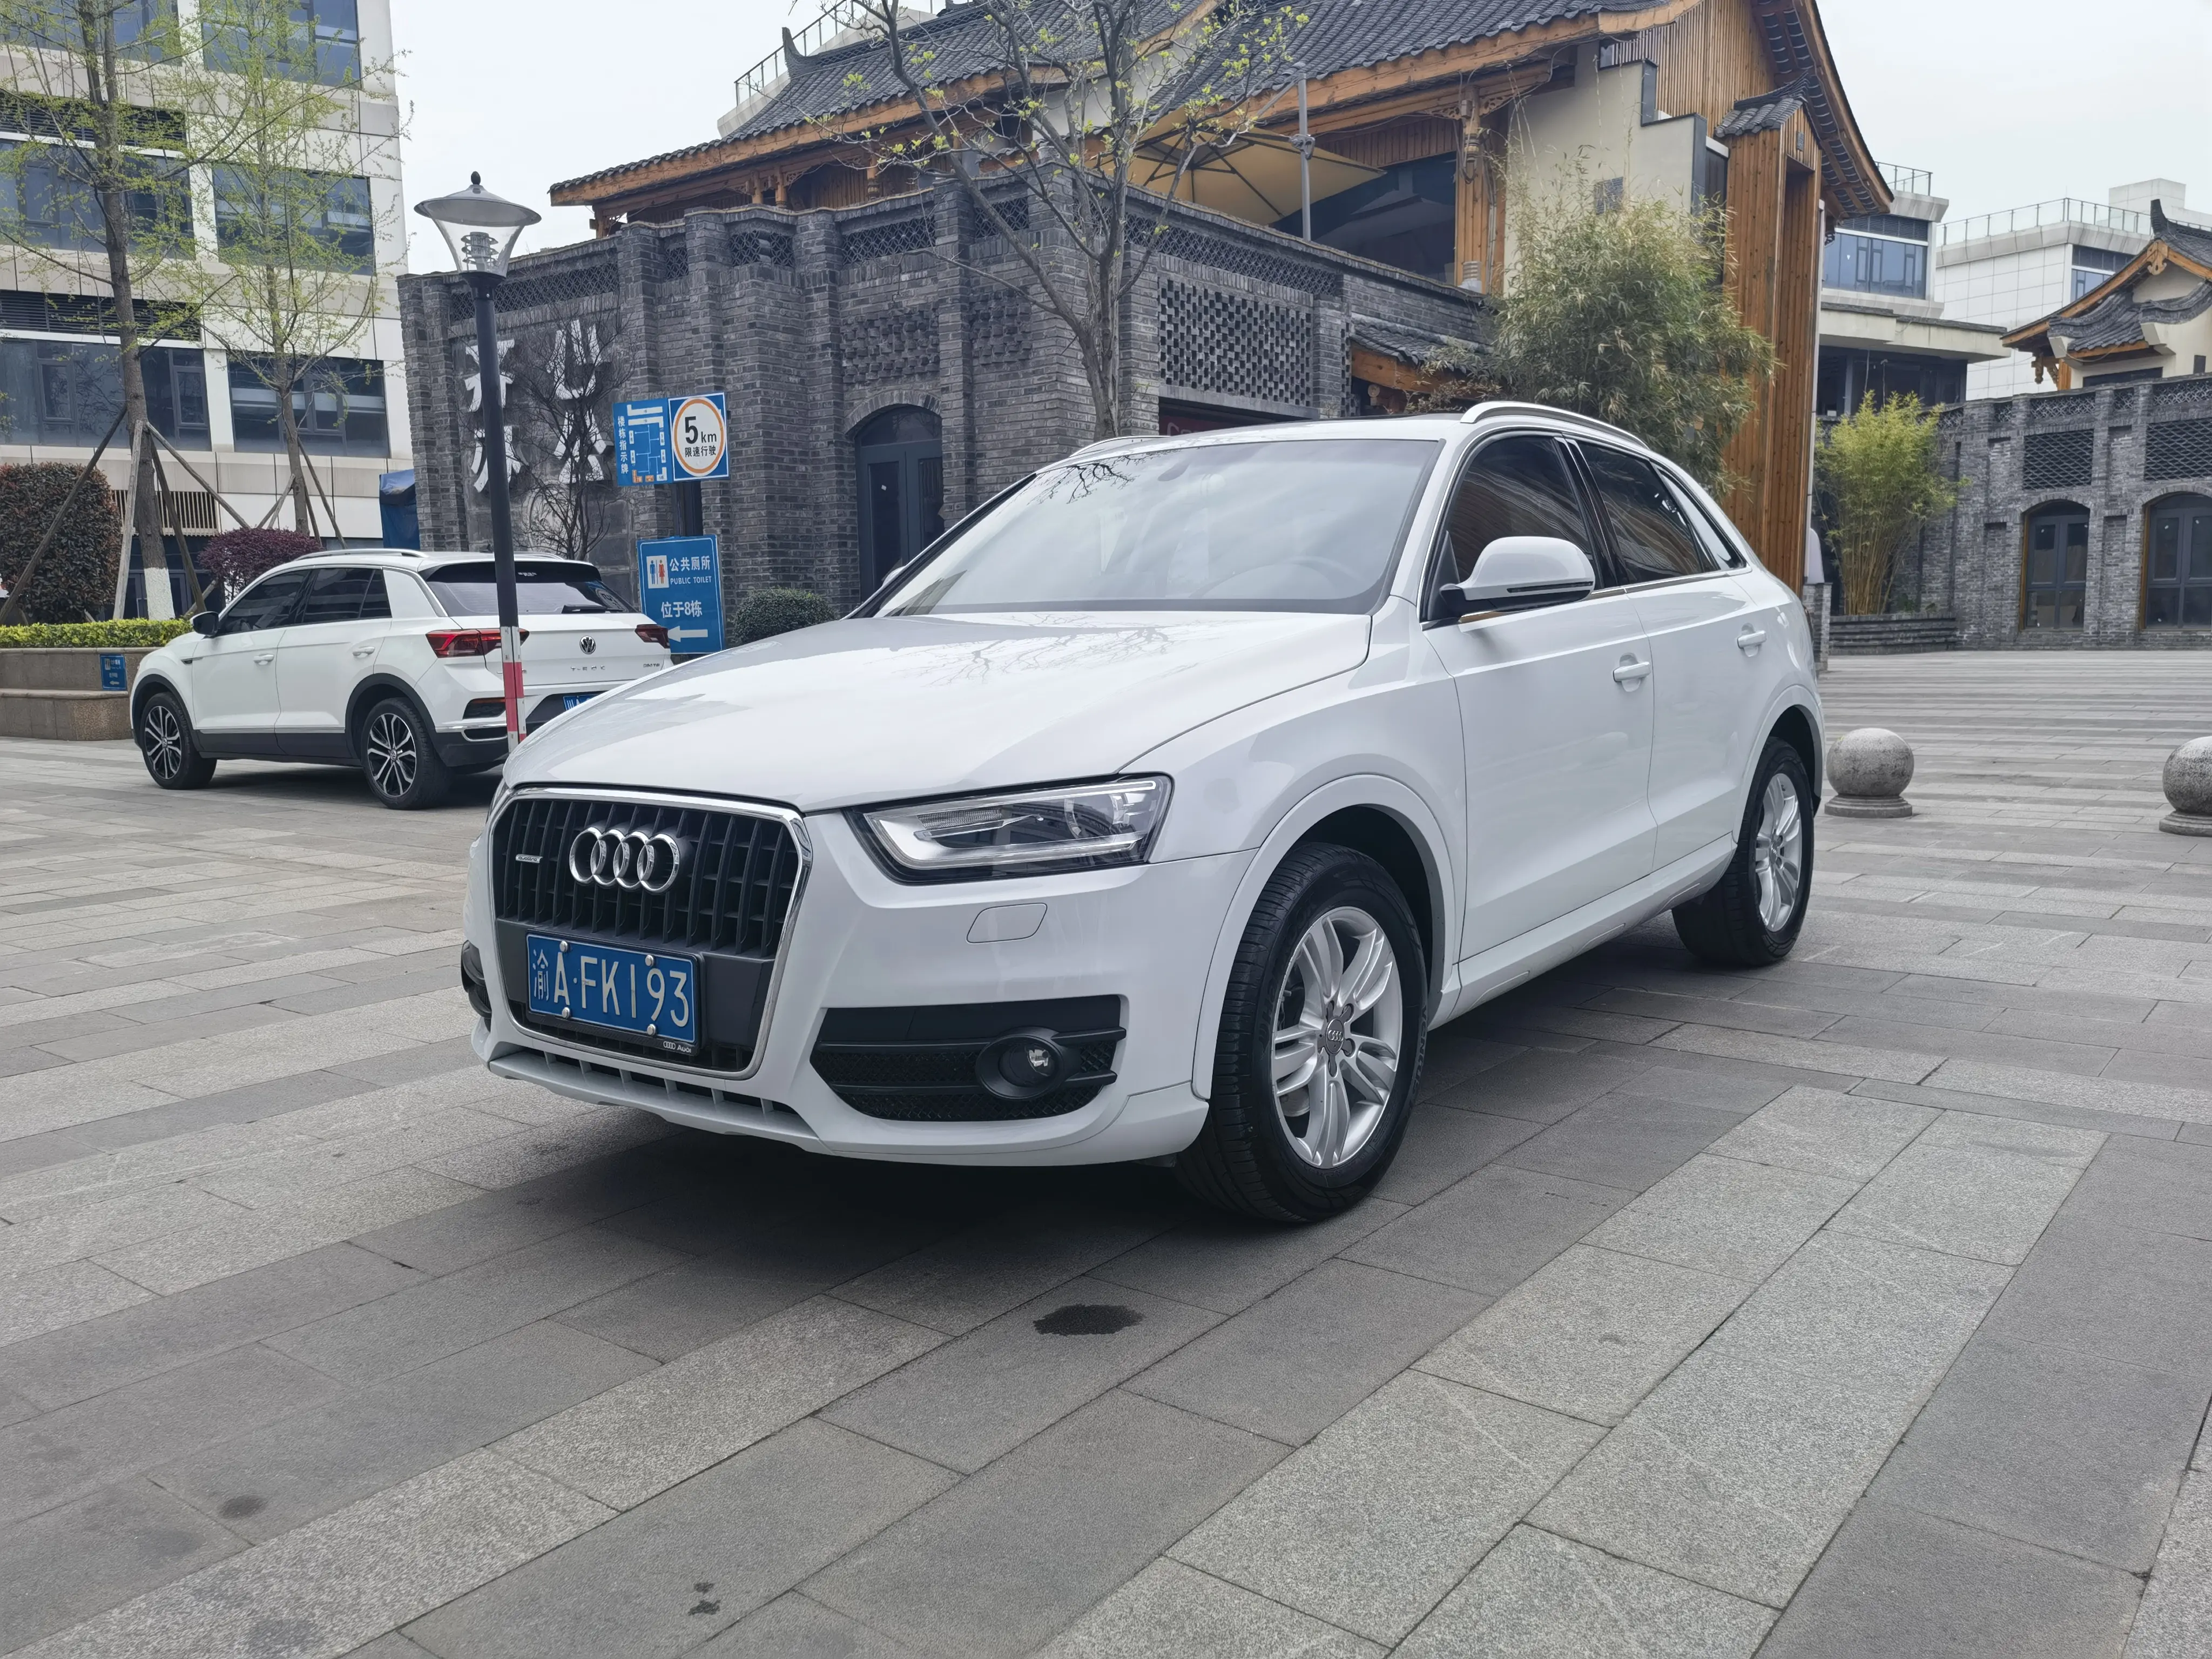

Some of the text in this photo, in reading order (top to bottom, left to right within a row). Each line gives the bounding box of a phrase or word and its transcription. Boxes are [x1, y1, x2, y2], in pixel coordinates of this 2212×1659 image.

[618, 416, 629, 474] 楼栋指示牌
[685, 446, 717, 458] 限速行驶
[670, 555, 711, 572] 公共厕所
[670, 576, 712, 585] PUBLIC TOILET
[660, 600, 703, 618] 位于8栋
[677, 1044, 691, 1053] Audi
